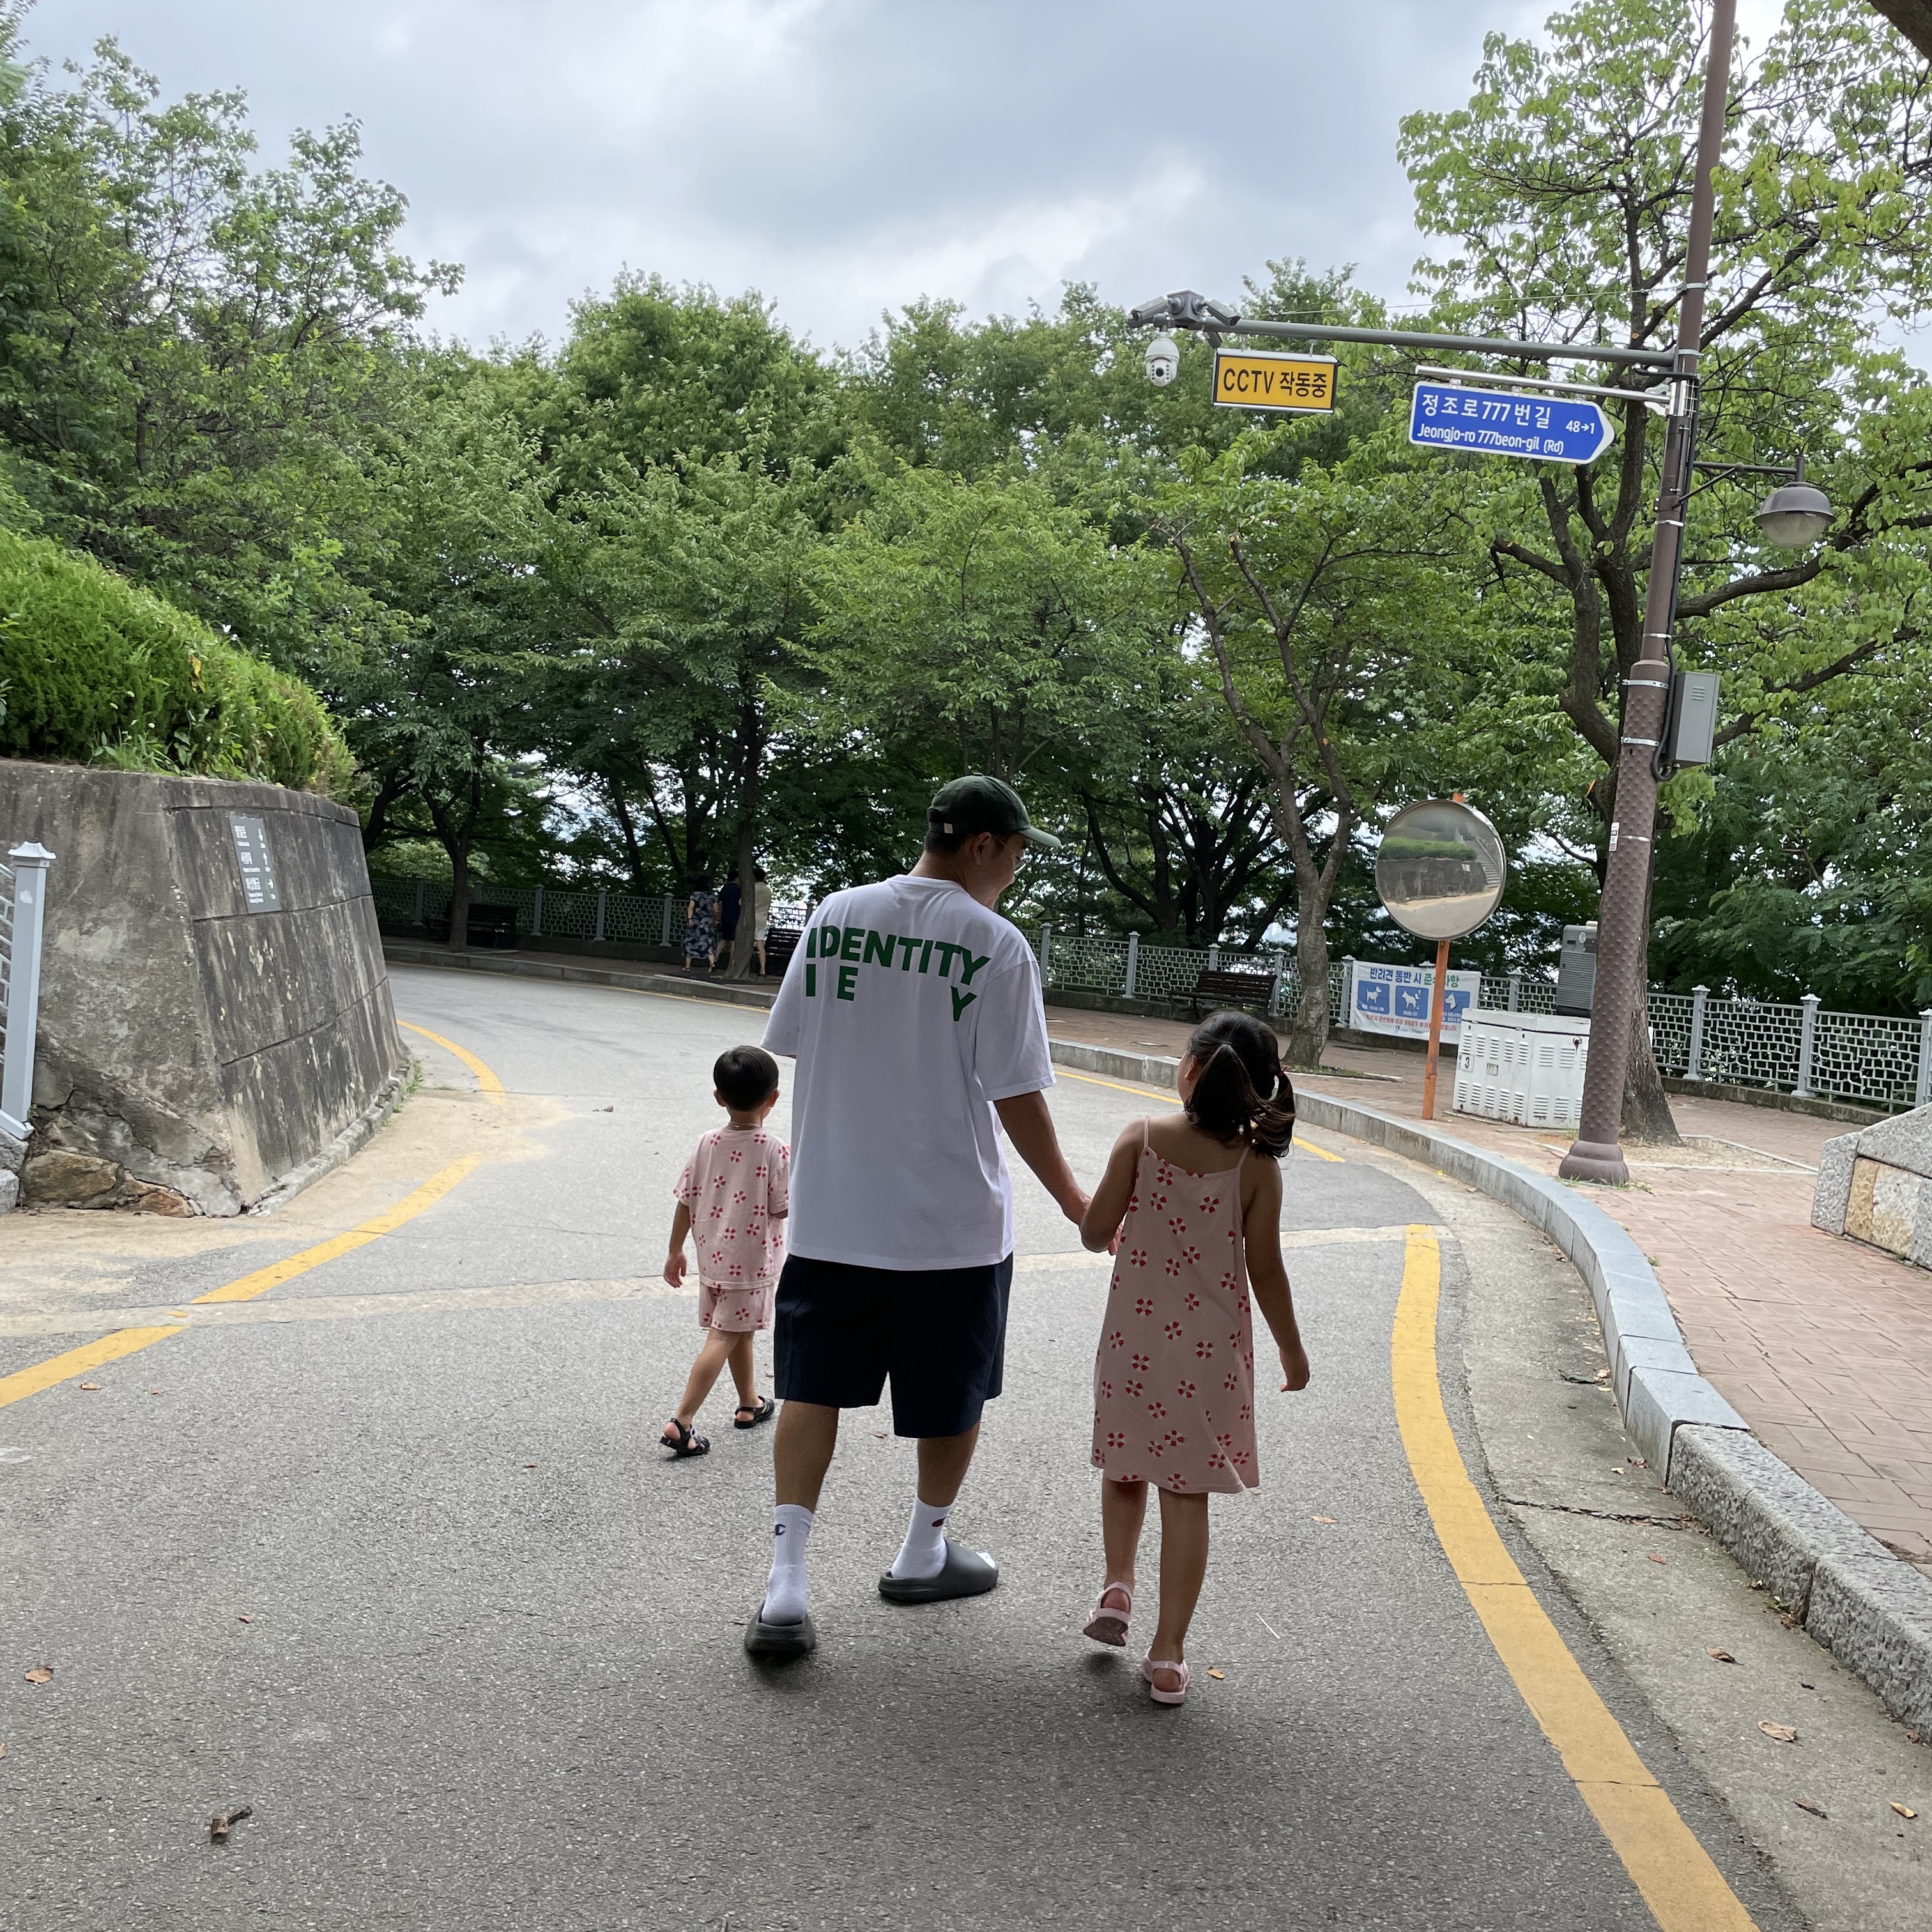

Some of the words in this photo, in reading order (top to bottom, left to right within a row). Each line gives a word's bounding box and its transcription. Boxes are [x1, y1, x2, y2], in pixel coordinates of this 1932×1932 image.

[1223, 368, 1275, 394] CCTV
[1279, 371, 1327, 398] 작동중
[1422, 394, 1551, 429] 정조로777번길
[1417, 424, 1476, 443] Jeongjo-ro
[1477, 430, 1539, 452] 777beon-gil
[1544, 440, 1564, 455] (Rd)
[806, 925, 992, 985] IDENTITY
[1370, 967, 1393, 981] 반려견
[1395, 970, 1411, 983] 동반
[1413, 972, 1422, 985] 시
[1465, 1057, 1469, 1068] 3
